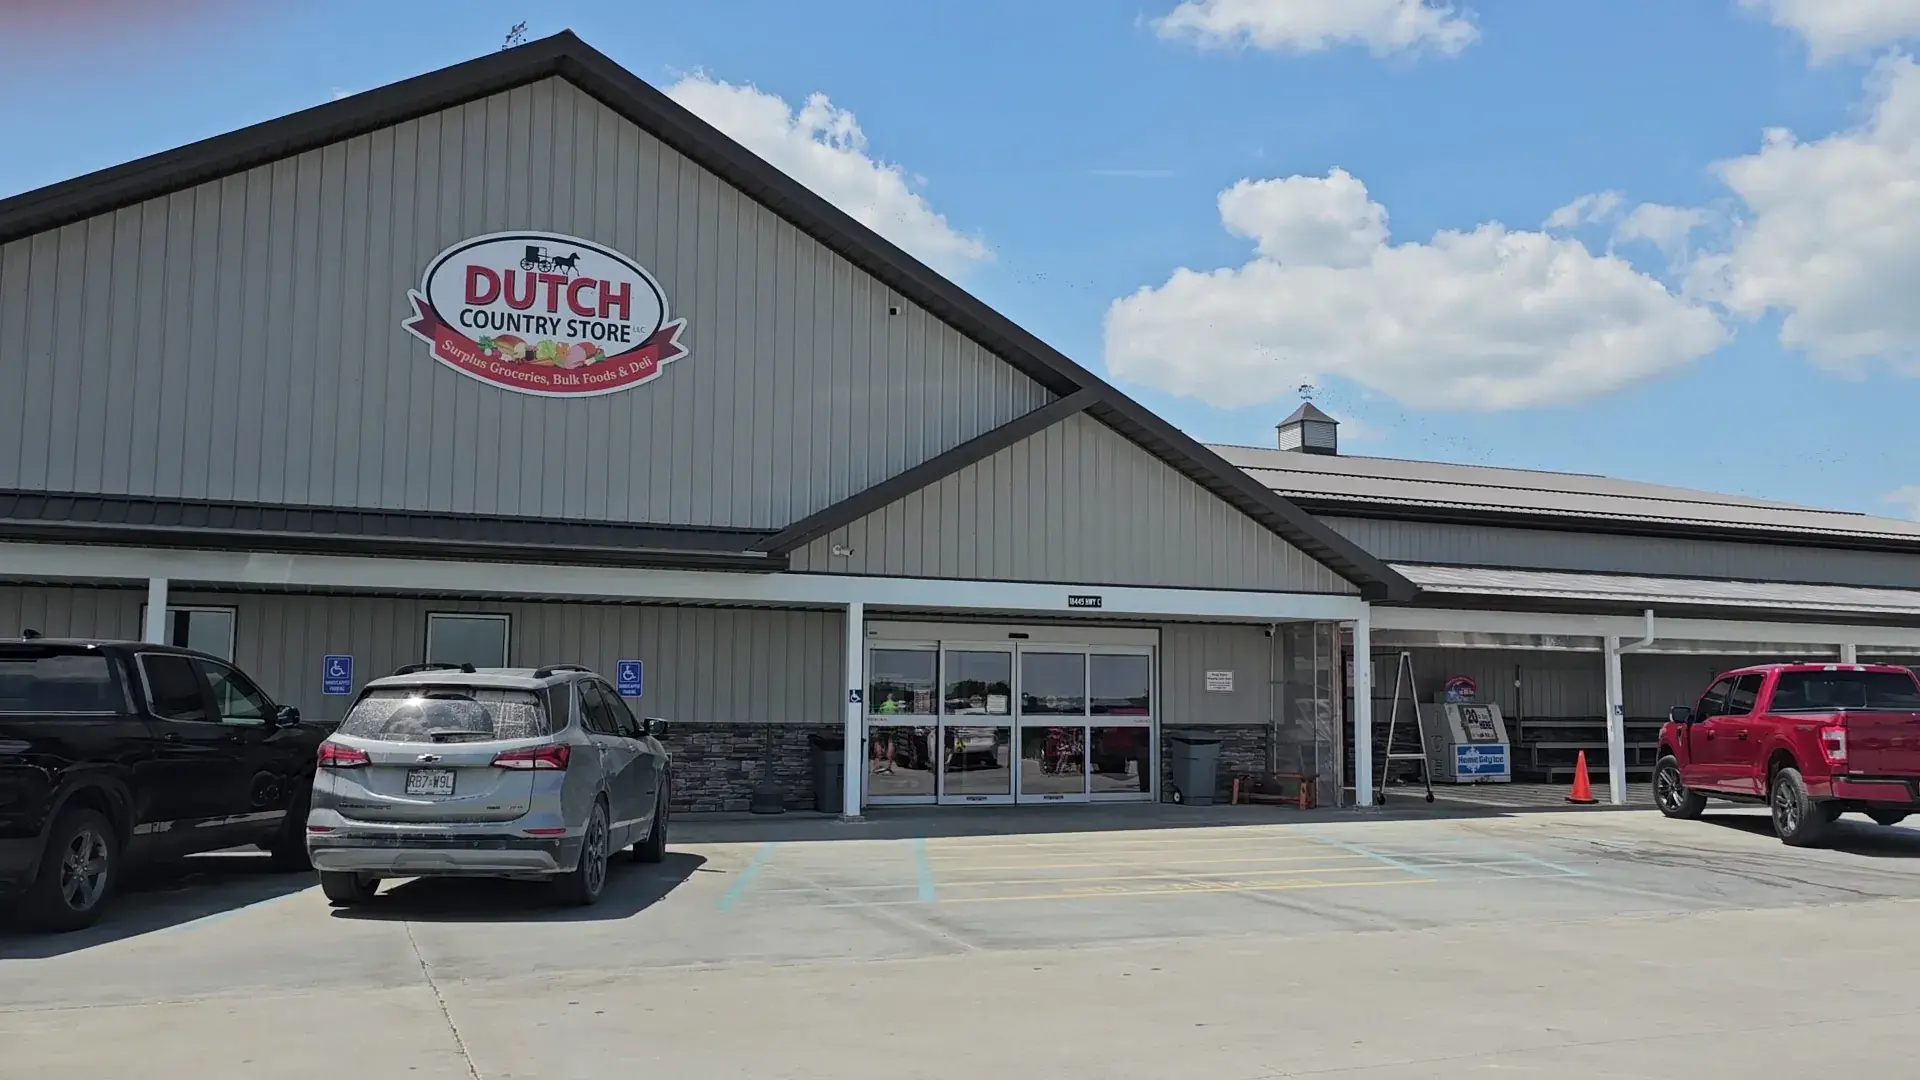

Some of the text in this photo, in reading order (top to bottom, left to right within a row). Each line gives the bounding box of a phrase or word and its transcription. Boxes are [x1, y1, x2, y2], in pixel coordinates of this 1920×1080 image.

[465, 265, 630, 321] DUTCH
[460, 308, 646, 343] COUNTRY STORE LLC
[441, 339, 653, 385] Surplus Groceries, Bulk Foods & Deli
